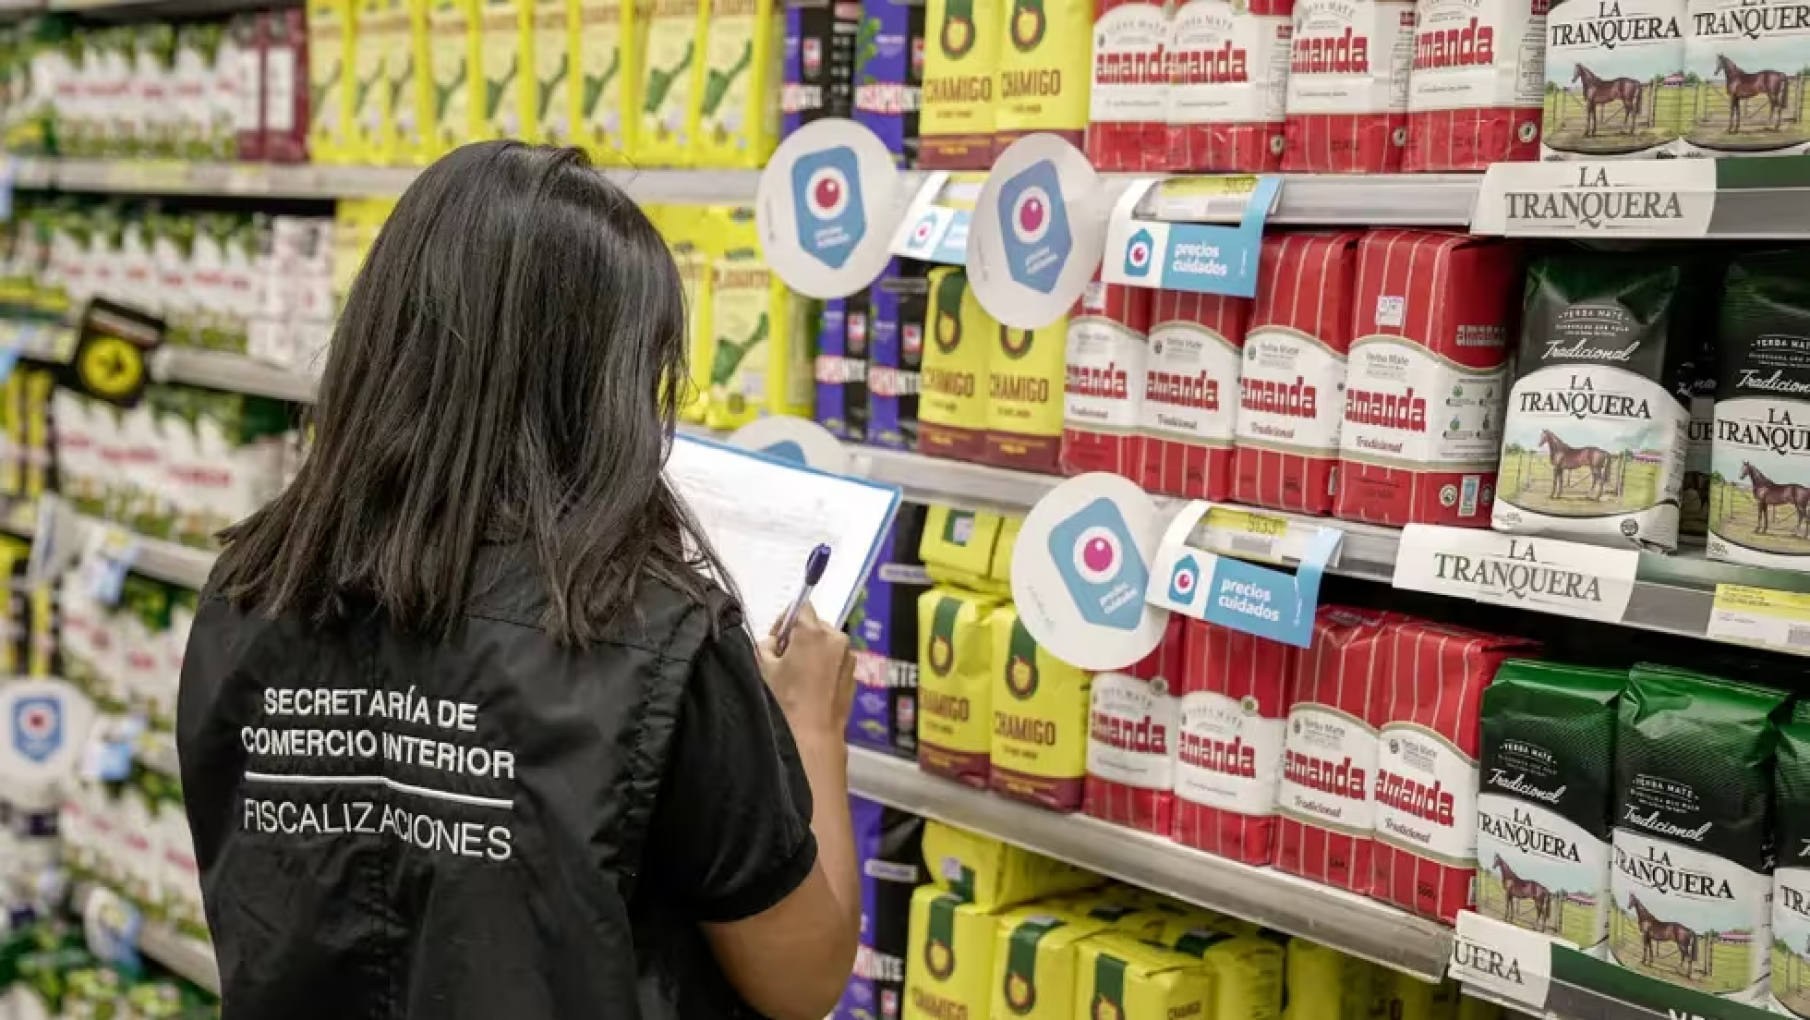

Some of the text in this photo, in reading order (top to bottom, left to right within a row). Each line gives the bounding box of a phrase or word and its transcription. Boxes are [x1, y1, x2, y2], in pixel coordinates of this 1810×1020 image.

[1600, 2, 1621, 17] LA
[1694, 6, 1810, 40] TRANQUER
[1291, 26, 1368, 73] amanda
[1413, 17, 1493, 70] amanda
[1551, 16, 1682, 49] TRANQUERA
[1579, 166, 1610, 187] LA
[1505, 192, 1683, 229] TRANQUERA
[1172, 257, 1228, 277] cuidados
[1174, 241, 1220, 259] precios
[1541, 338, 1641, 362] Tradicional
[1145, 370, 1219, 412] amanda
[1241, 376, 1317, 419] amanda
[1570, 374, 1594, 391] LA
[1344, 386, 1427, 433] amanda
[1520, 391, 1652, 420] TRANQUERA
[1767, 407, 1792, 425] LA
[1356, 435, 1403, 453] Tradicional
[1508, 539, 1538, 562] LA
[1221, 577, 1273, 601] precios
[1434, 553, 1602, 600] TRANQUERA
[1218, 594, 1281, 623] cuidados
[264, 685, 478, 732] SECRETARÍA DE
[241, 726, 516, 779] COMERCIO INTERIOR
[1179, 730, 1257, 779] amanda
[1284, 749, 1367, 802] amanda
[1487, 768, 1567, 805] Tradicional
[1374, 769, 1455, 828] amanda
[244, 798, 513, 861] FISCALIZACIONES
[1514, 806, 1532, 827] LA
[1623, 803, 1713, 841] Tradicional
[1648, 845, 1672, 867] LA
